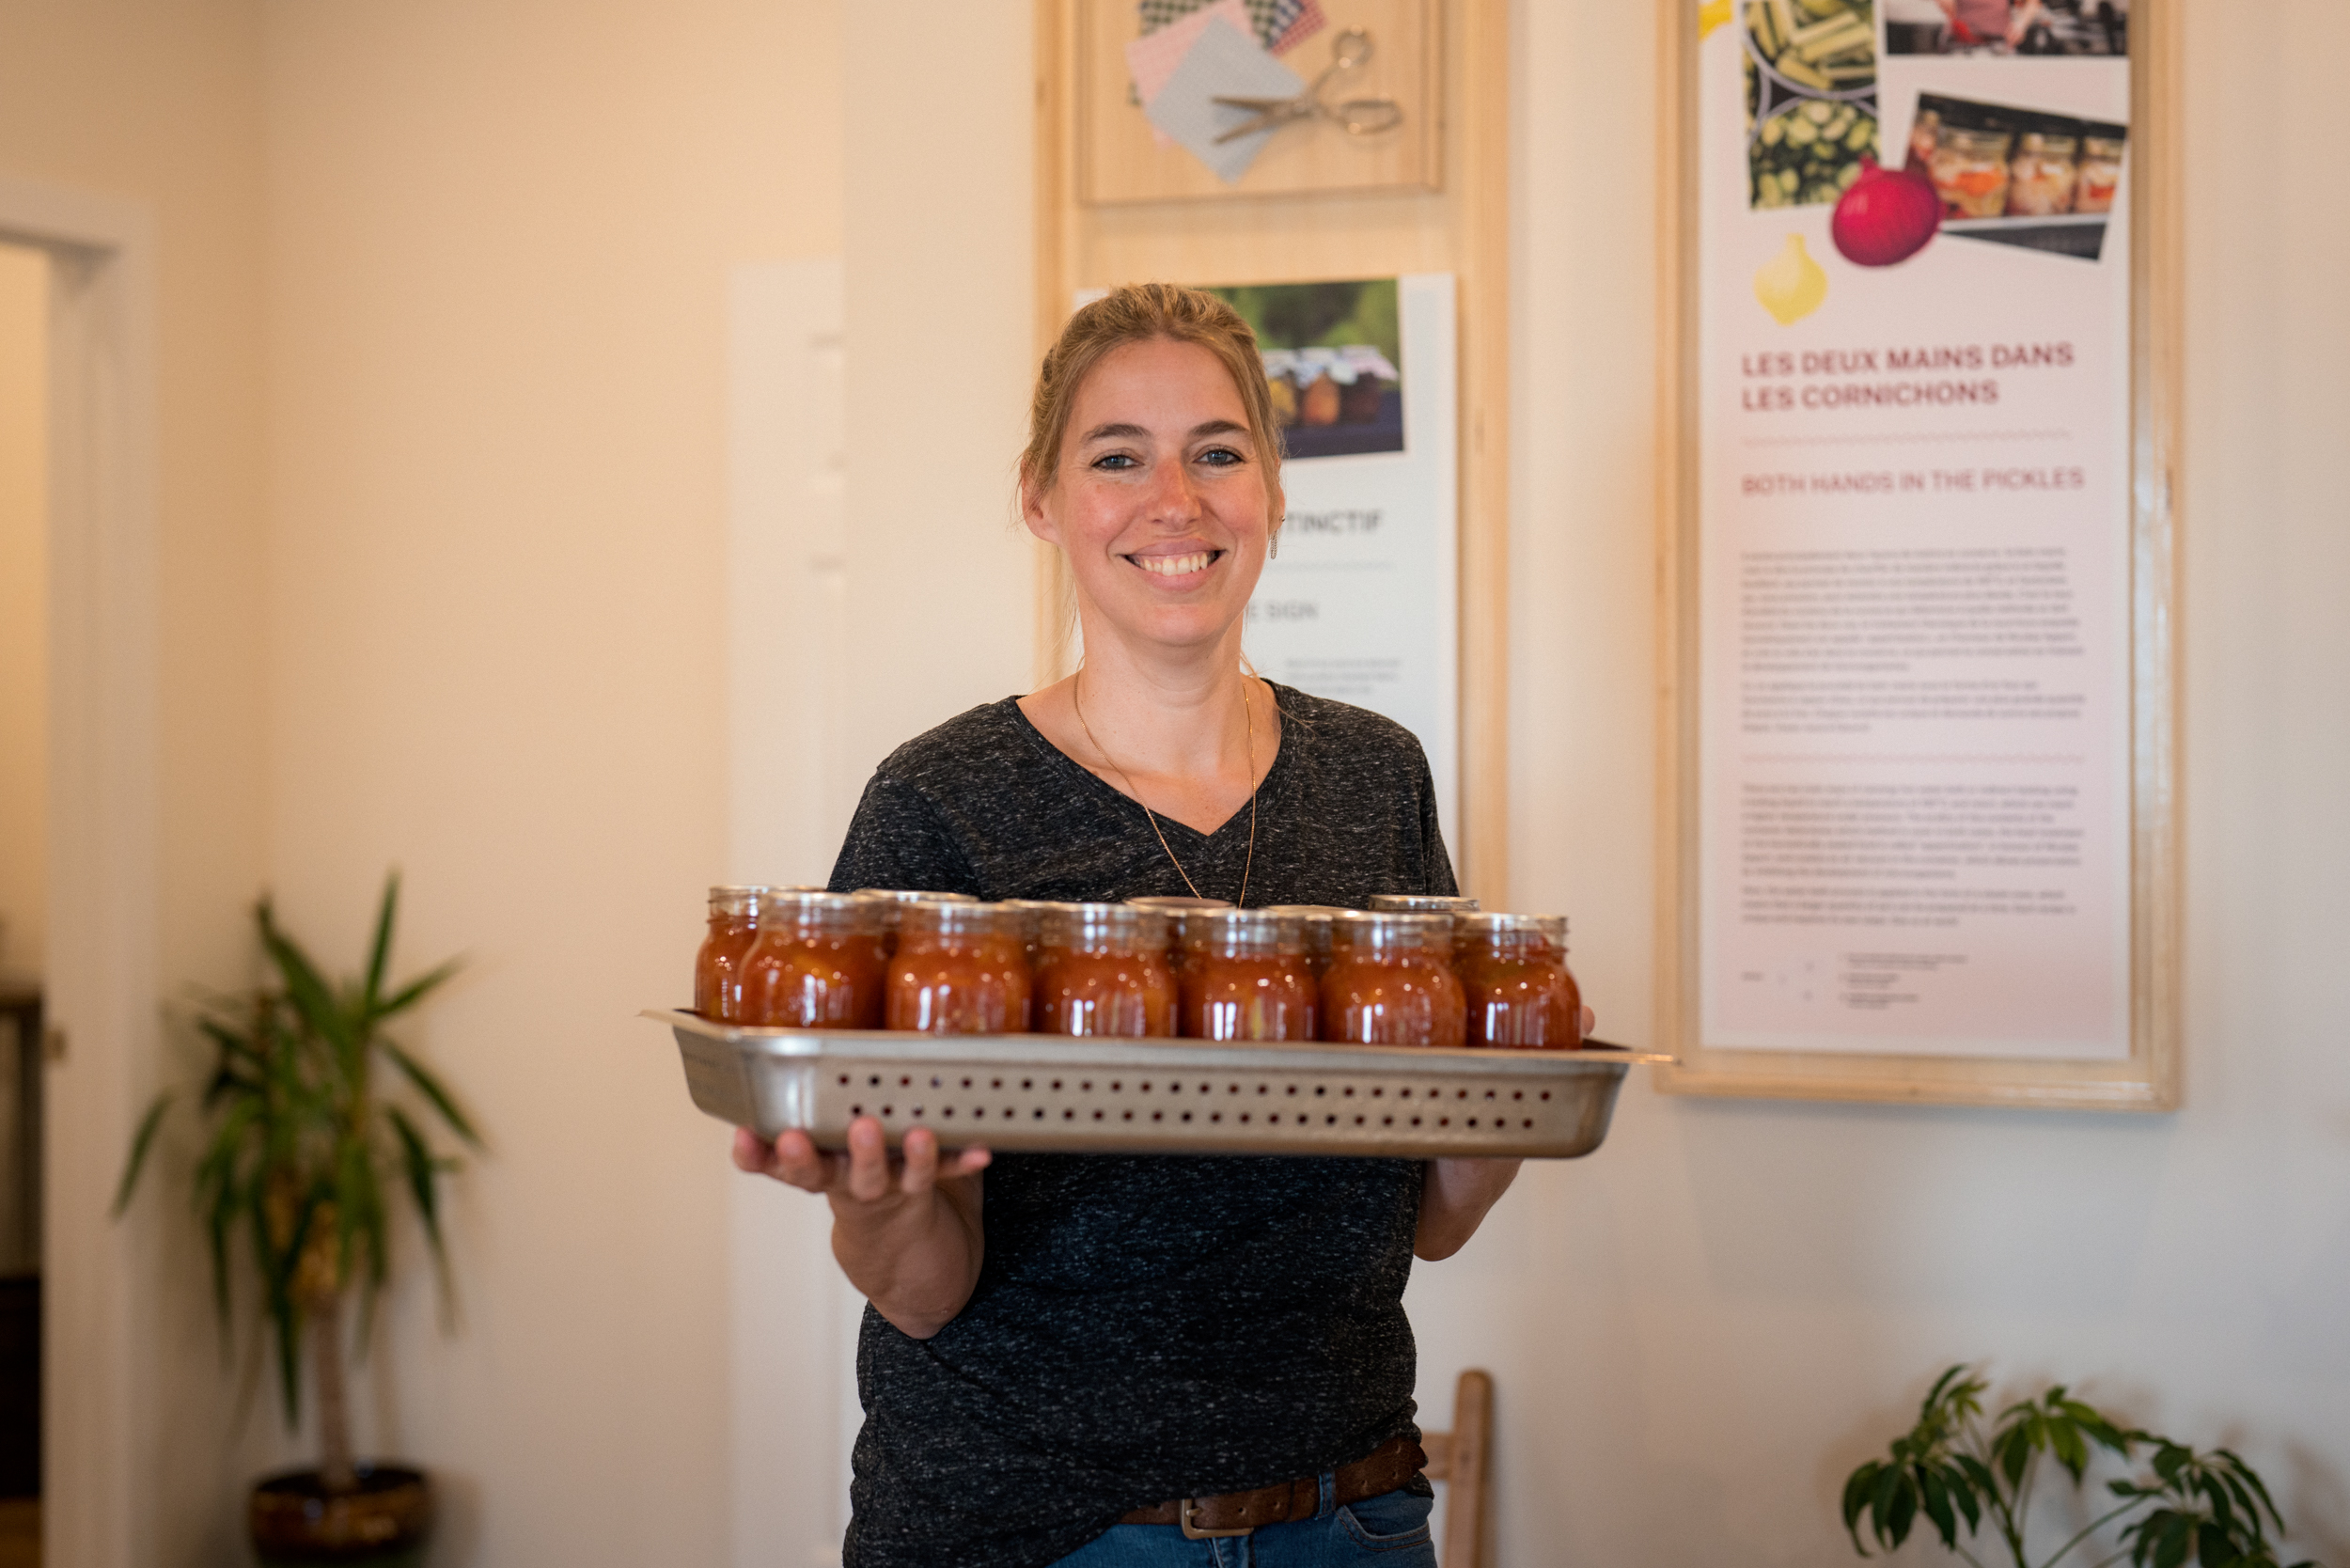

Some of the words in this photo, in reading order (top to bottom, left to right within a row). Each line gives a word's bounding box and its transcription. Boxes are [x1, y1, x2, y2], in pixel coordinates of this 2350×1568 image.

[1742, 352, 1794, 377] LES
[1801, 350, 1878, 375] DEUX
[1886, 345, 1983, 370] MAINS
[1991, 342, 2075, 368] DANS
[1742, 386, 1794, 411] LES
[1800, 380, 1999, 410] CORNICHONS
[1741, 474, 1807, 497] BOTH
[1810, 472, 1894, 494] HANDS
[1899, 471, 1926, 494] IN
[1932, 469, 1975, 493] THE
[1982, 466, 2085, 491] PICKLES
[1264, 600, 1319, 622] SIGN
